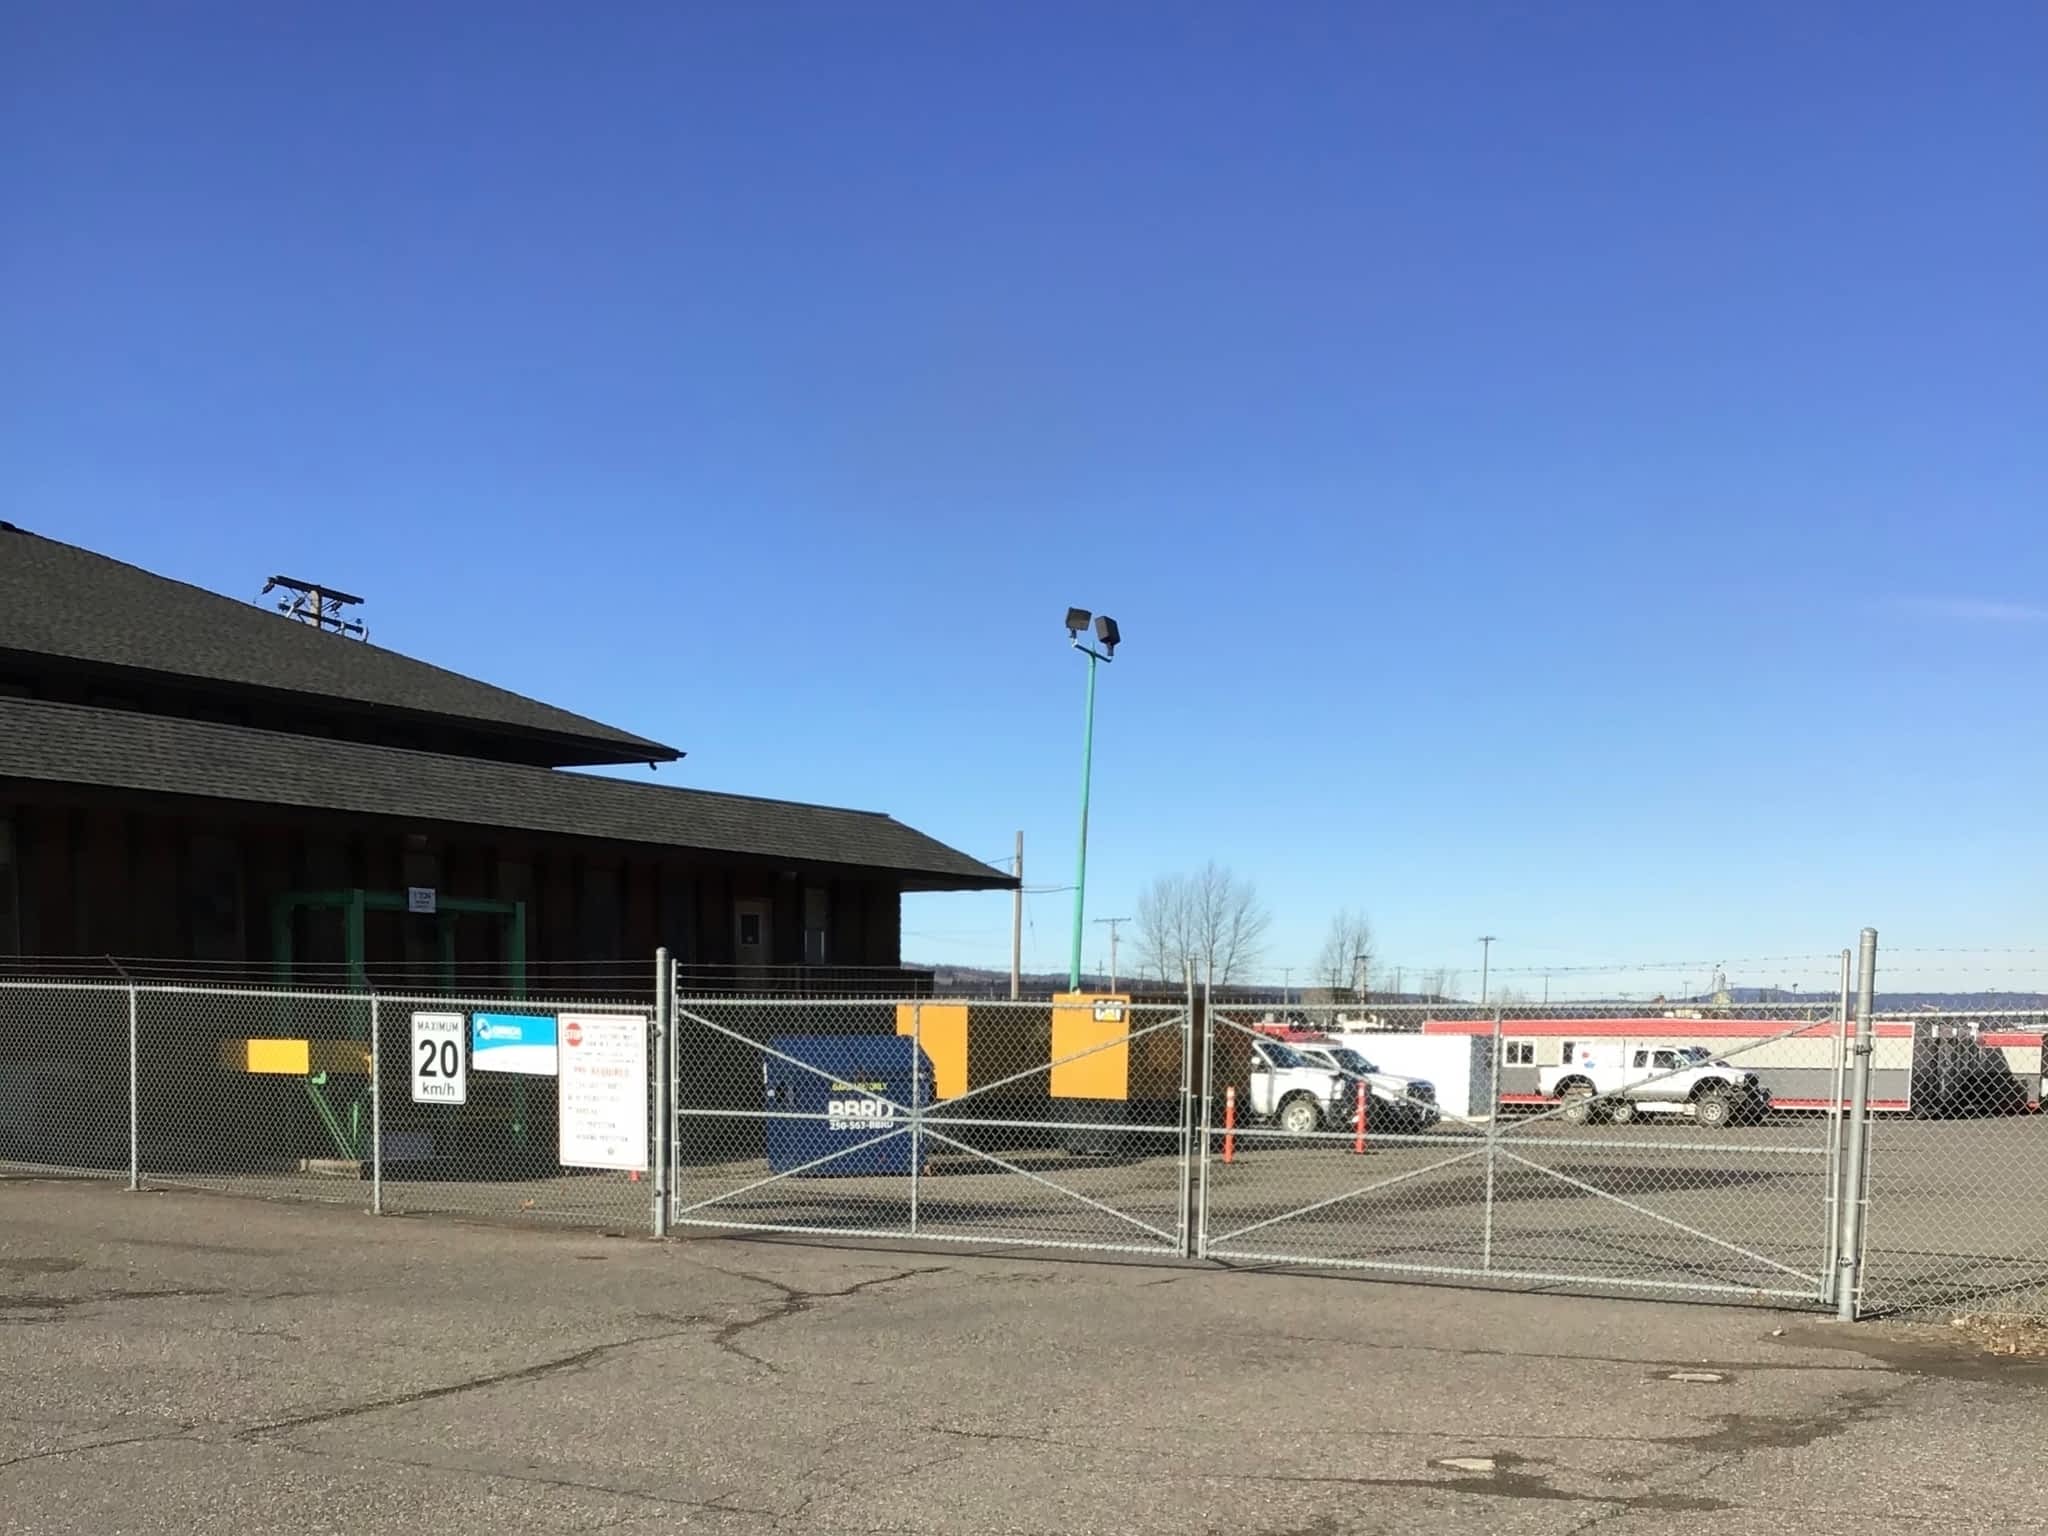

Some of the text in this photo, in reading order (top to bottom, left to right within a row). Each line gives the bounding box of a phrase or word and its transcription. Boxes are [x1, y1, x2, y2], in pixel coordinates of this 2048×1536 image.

[417, 1021, 459, 1032] MAXIMUM
[418, 1039, 459, 1079] 20
[422, 1082, 455, 1096] km/h
[828, 1100, 894, 1119] BBRD
